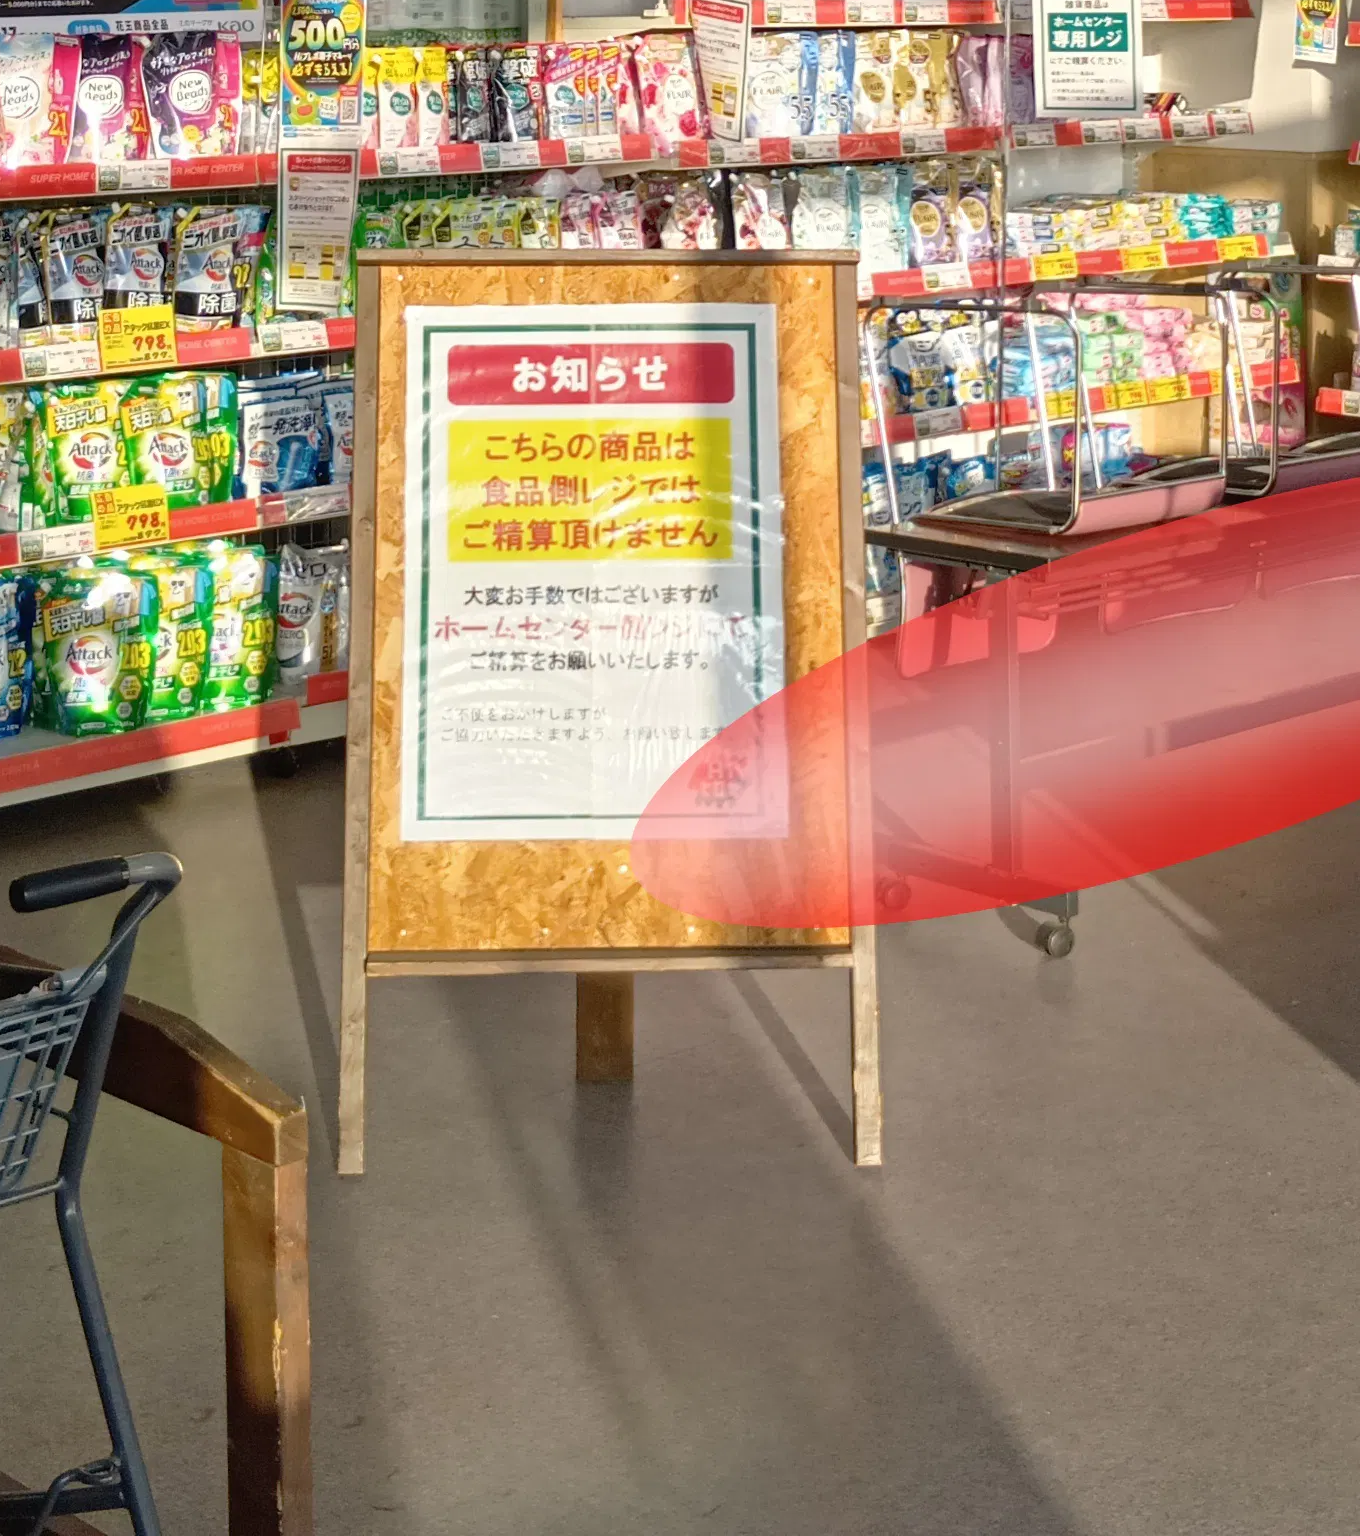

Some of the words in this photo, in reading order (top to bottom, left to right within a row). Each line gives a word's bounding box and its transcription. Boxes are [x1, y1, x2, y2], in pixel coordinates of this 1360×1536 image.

[1053, 16, 1124, 28] ホームセンター
[1051, 29, 1123, 49] 専用レジ
[177, 86, 209, 100] Beads
[179, 78, 203, 89] New
[131, 254, 163, 270] Attack
[198, 293, 237, 314] 除菌
[512, 355, 669, 394] お知らせ
[68, 441, 112, 457] Attack
[148, 437, 189, 454] Attack
[483, 429, 696, 464] こちらの商品は
[480, 474, 702, 510] 食品側レジでは
[462, 518, 720, 553] ご精算頂けません
[463, 583, 720, 607] 大変お手数ではございますが
[66, 640, 113, 661] Attack
